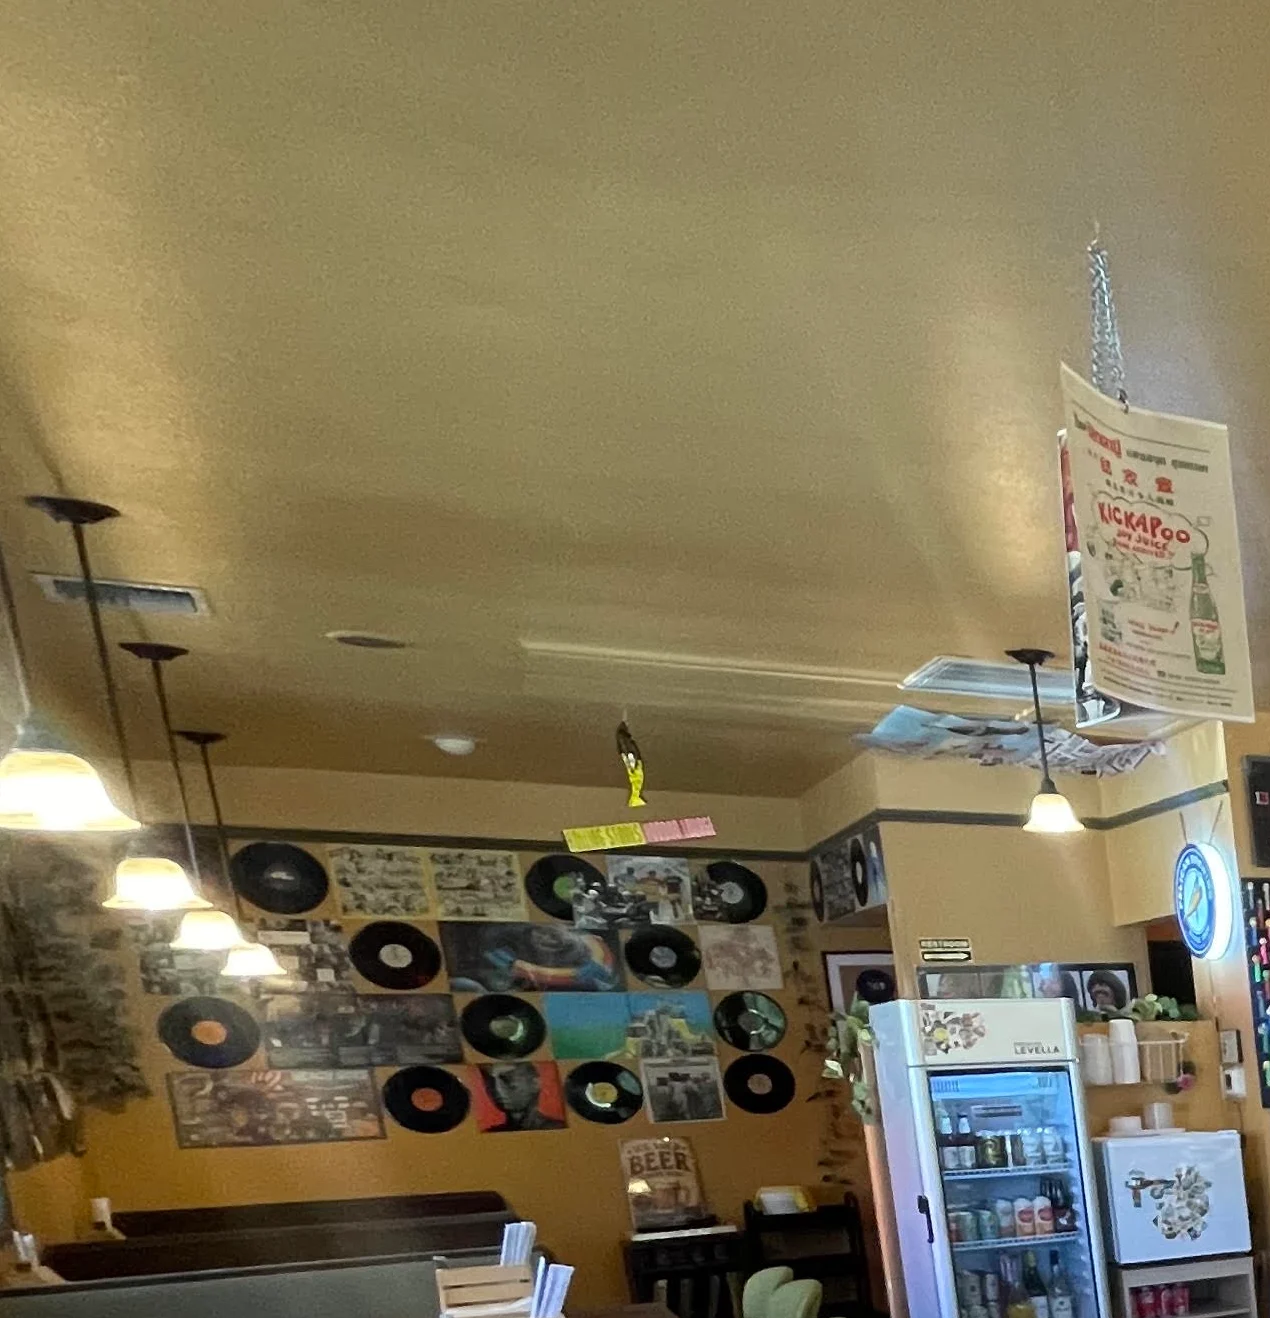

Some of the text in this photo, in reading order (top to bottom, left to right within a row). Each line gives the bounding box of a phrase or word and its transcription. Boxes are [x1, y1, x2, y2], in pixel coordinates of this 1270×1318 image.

[1098, 502, 1191, 543] KICKAPOO
[1014, 1046, 1060, 1055] LEVELLA
[630, 1151, 692, 1176] BEER
